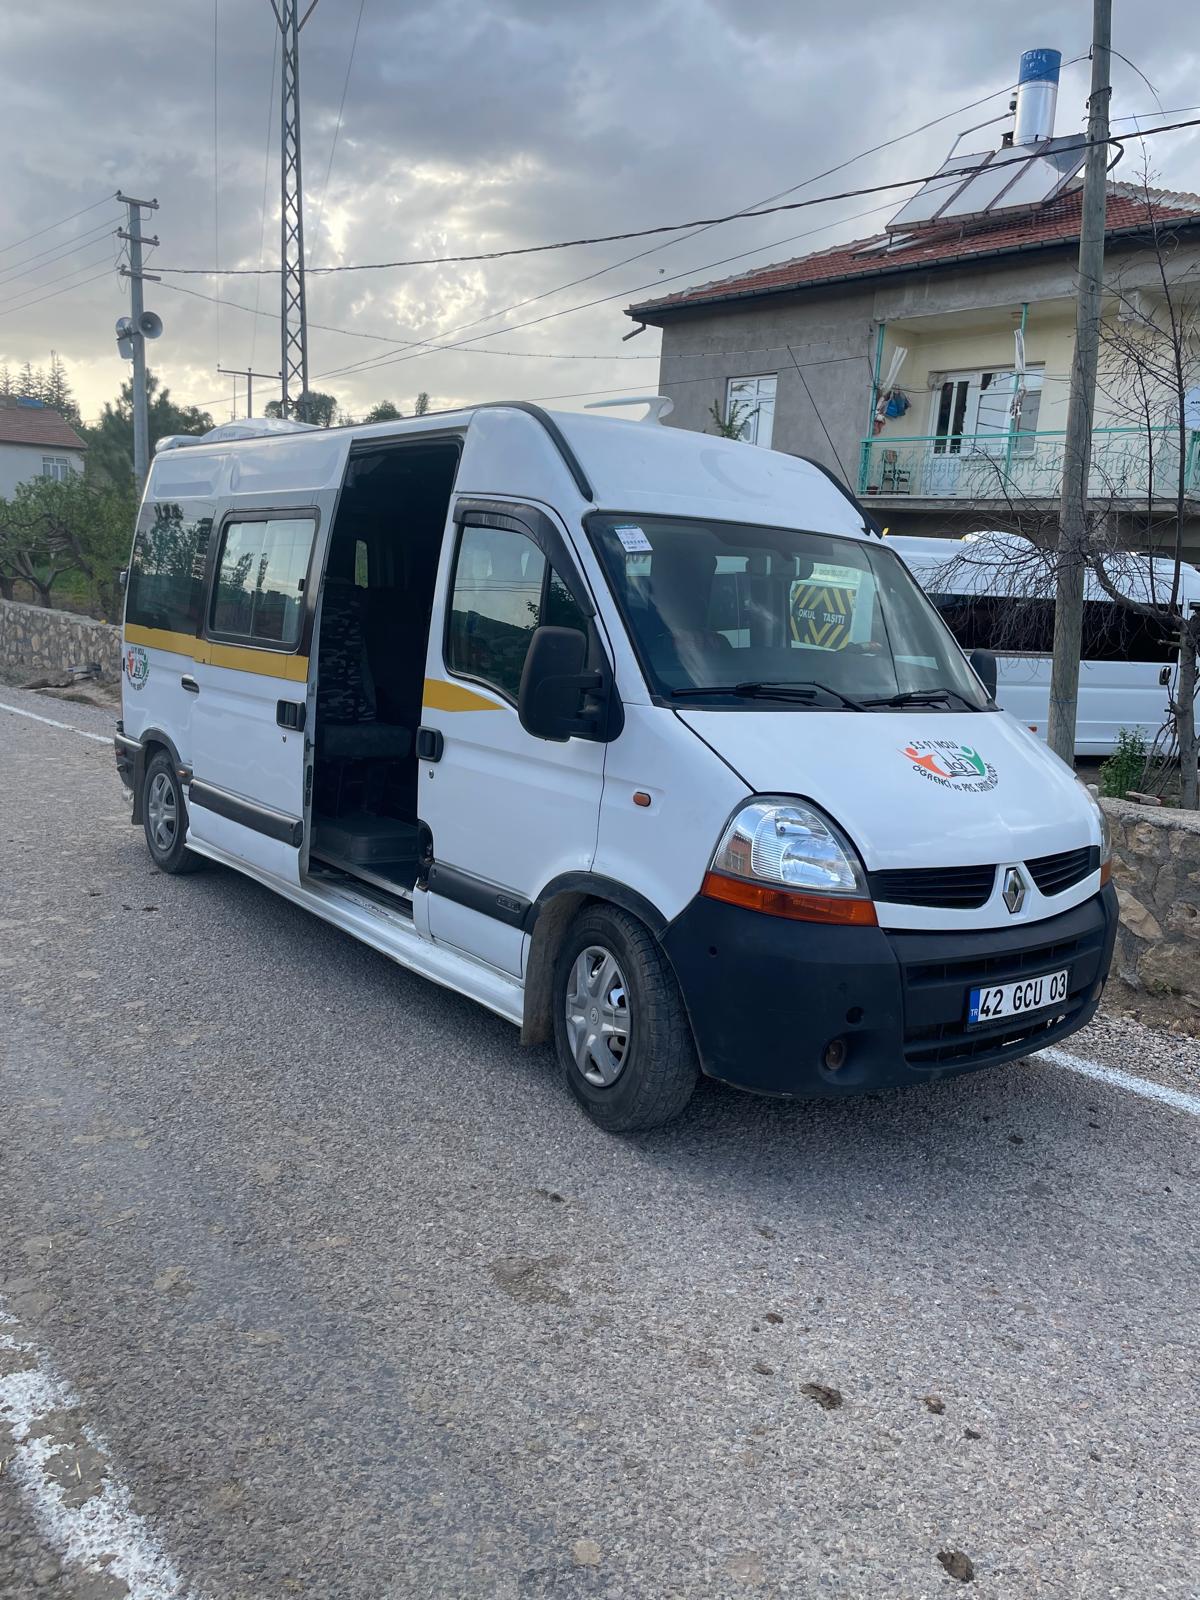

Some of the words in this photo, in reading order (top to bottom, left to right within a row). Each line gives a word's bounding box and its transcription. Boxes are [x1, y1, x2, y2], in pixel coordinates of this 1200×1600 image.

[970, 1008, 979, 1017] TR
[980, 989, 1003, 1016] 42
[1013, 980, 1042, 1010] GCU
[1050, 973, 1066, 1000] 03
